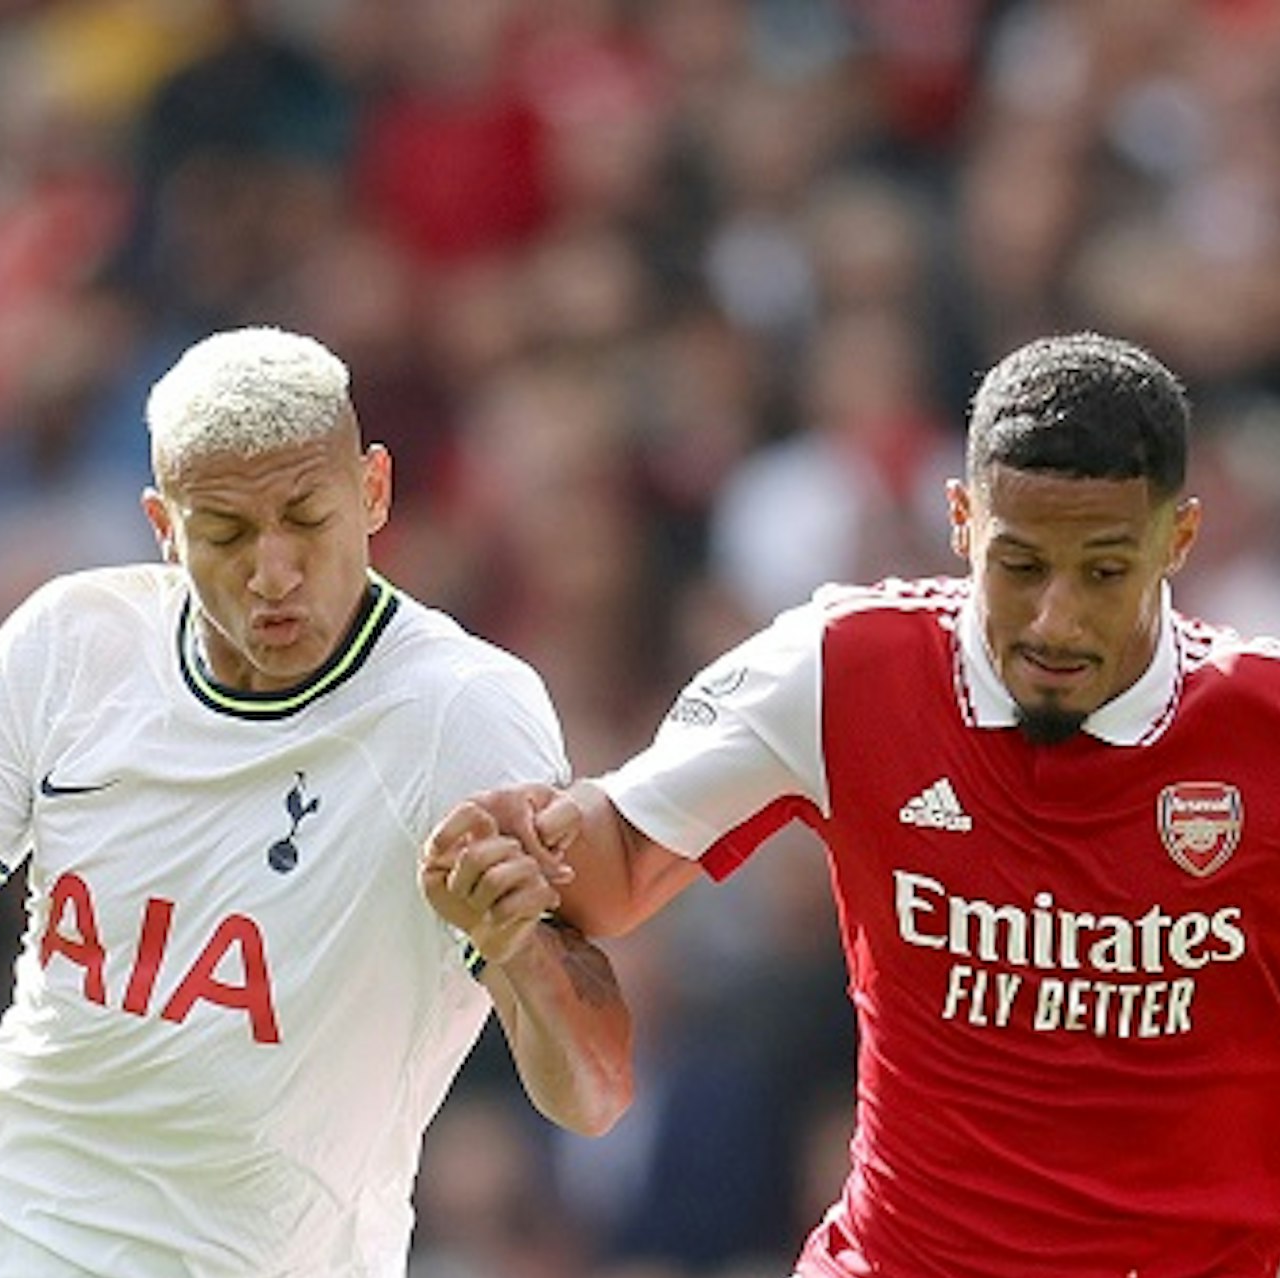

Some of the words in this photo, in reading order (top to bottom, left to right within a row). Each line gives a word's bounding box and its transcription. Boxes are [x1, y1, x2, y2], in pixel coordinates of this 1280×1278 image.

[39, 872, 283, 1045] AIA
[892, 869, 1246, 974] Emirates
[941, 964, 1022, 1028] FLY
[1033, 976, 1196, 1039] BETTER
